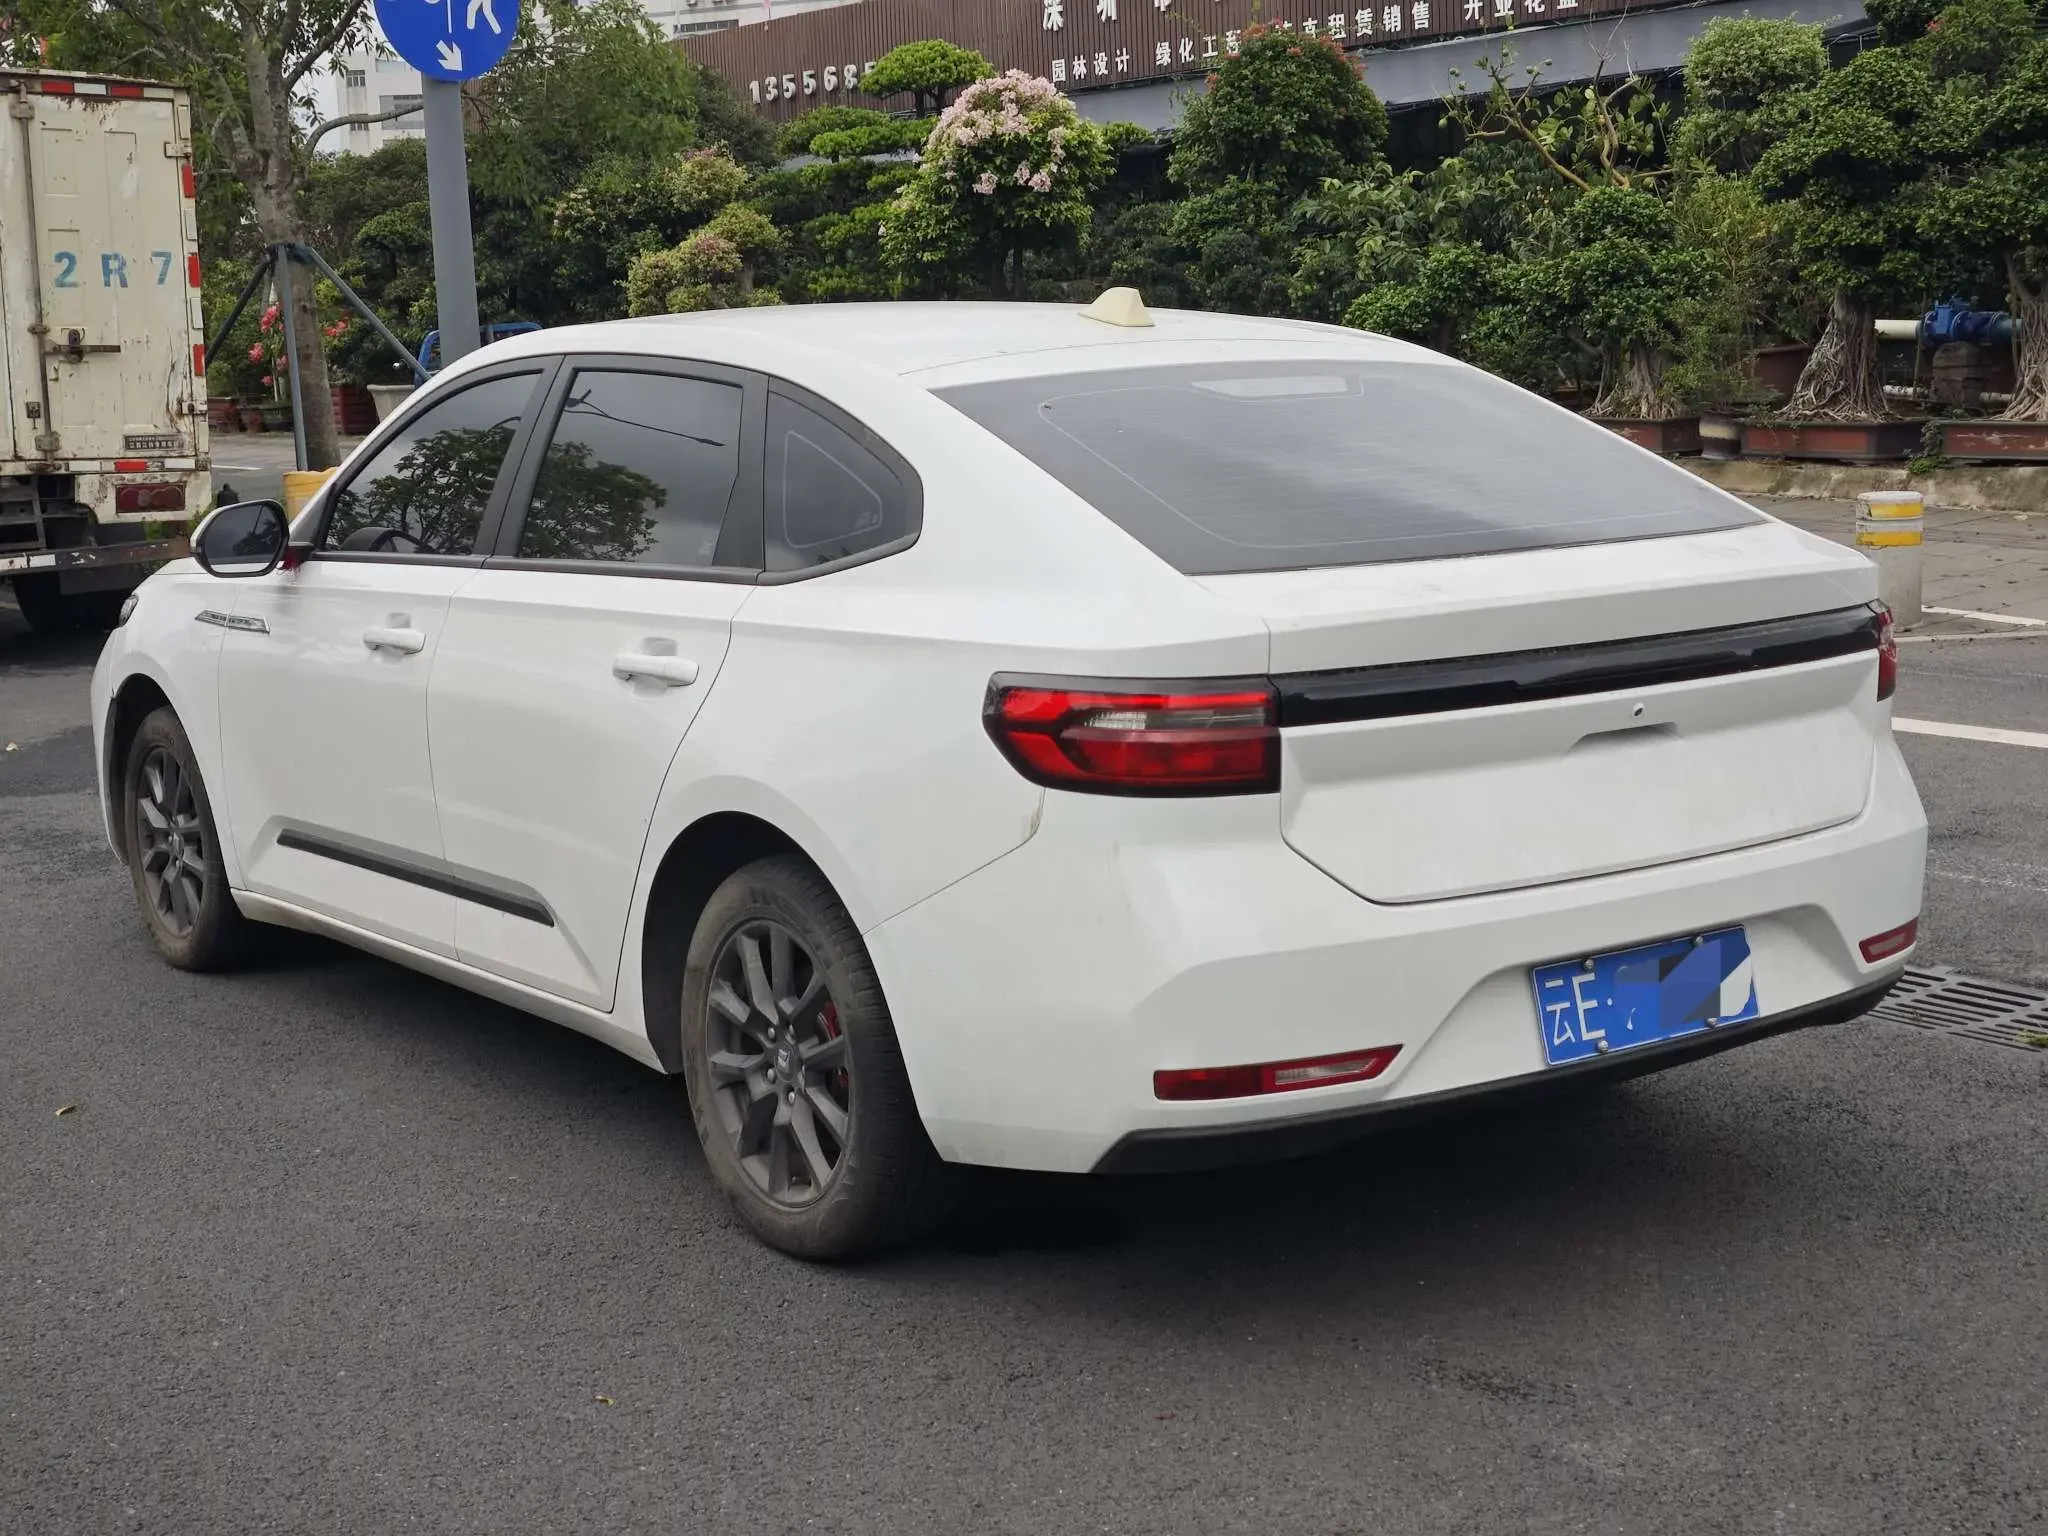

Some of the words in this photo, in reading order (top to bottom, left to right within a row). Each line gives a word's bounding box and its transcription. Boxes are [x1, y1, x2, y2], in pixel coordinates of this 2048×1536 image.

[1051, 47, 1131, 83] 园林设计
[54, 251, 79, 288] 2
[101, 253, 128, 288] R
[152, 251, 172, 285] 7
